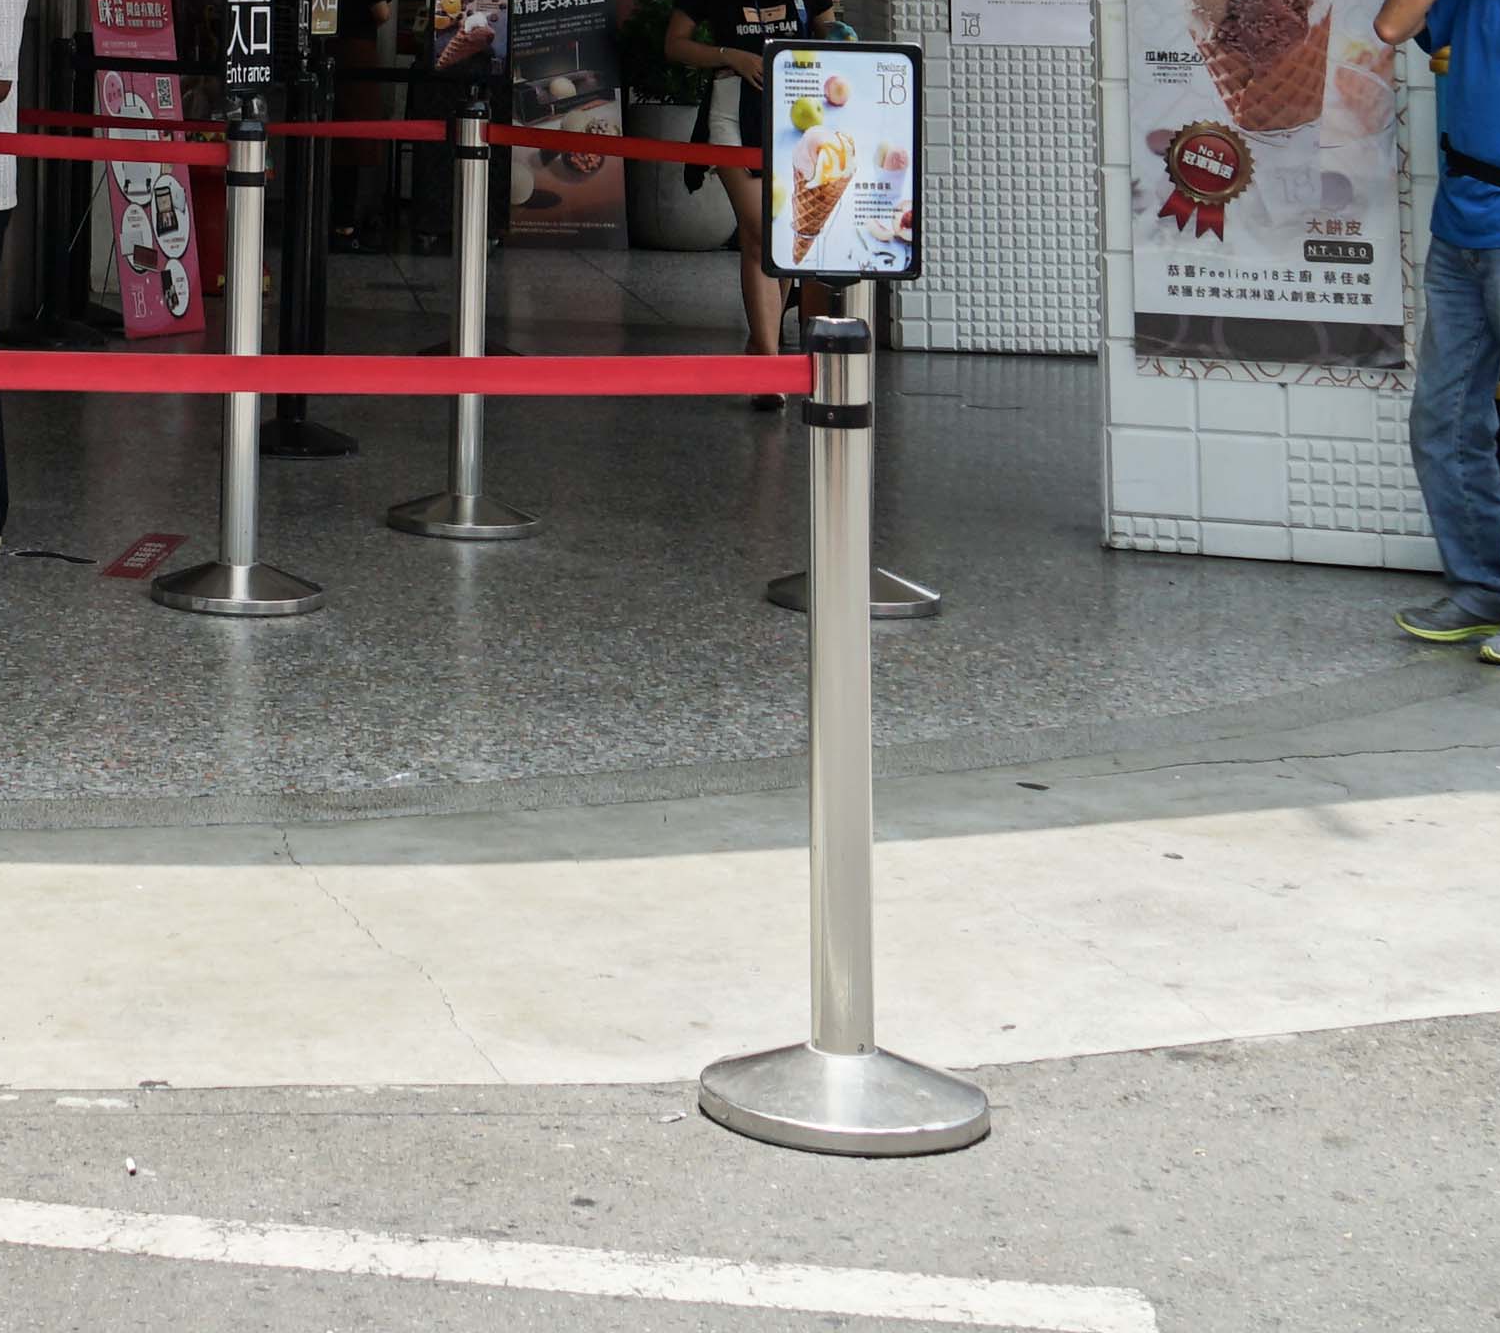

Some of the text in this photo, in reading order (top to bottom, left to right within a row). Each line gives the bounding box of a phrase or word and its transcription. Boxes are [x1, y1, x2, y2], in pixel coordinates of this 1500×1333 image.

[227, 5, 271, 56] 入口
[961, 17, 980, 37] 18
[227, 60, 270, 84] Entrance
[876, 74, 907, 105] 18
[1306, 218, 1362, 236] 大餅皮
[1167, 285, 1373, 305] 榮獲台灣冰淇淋達人創意大賽冠軍
